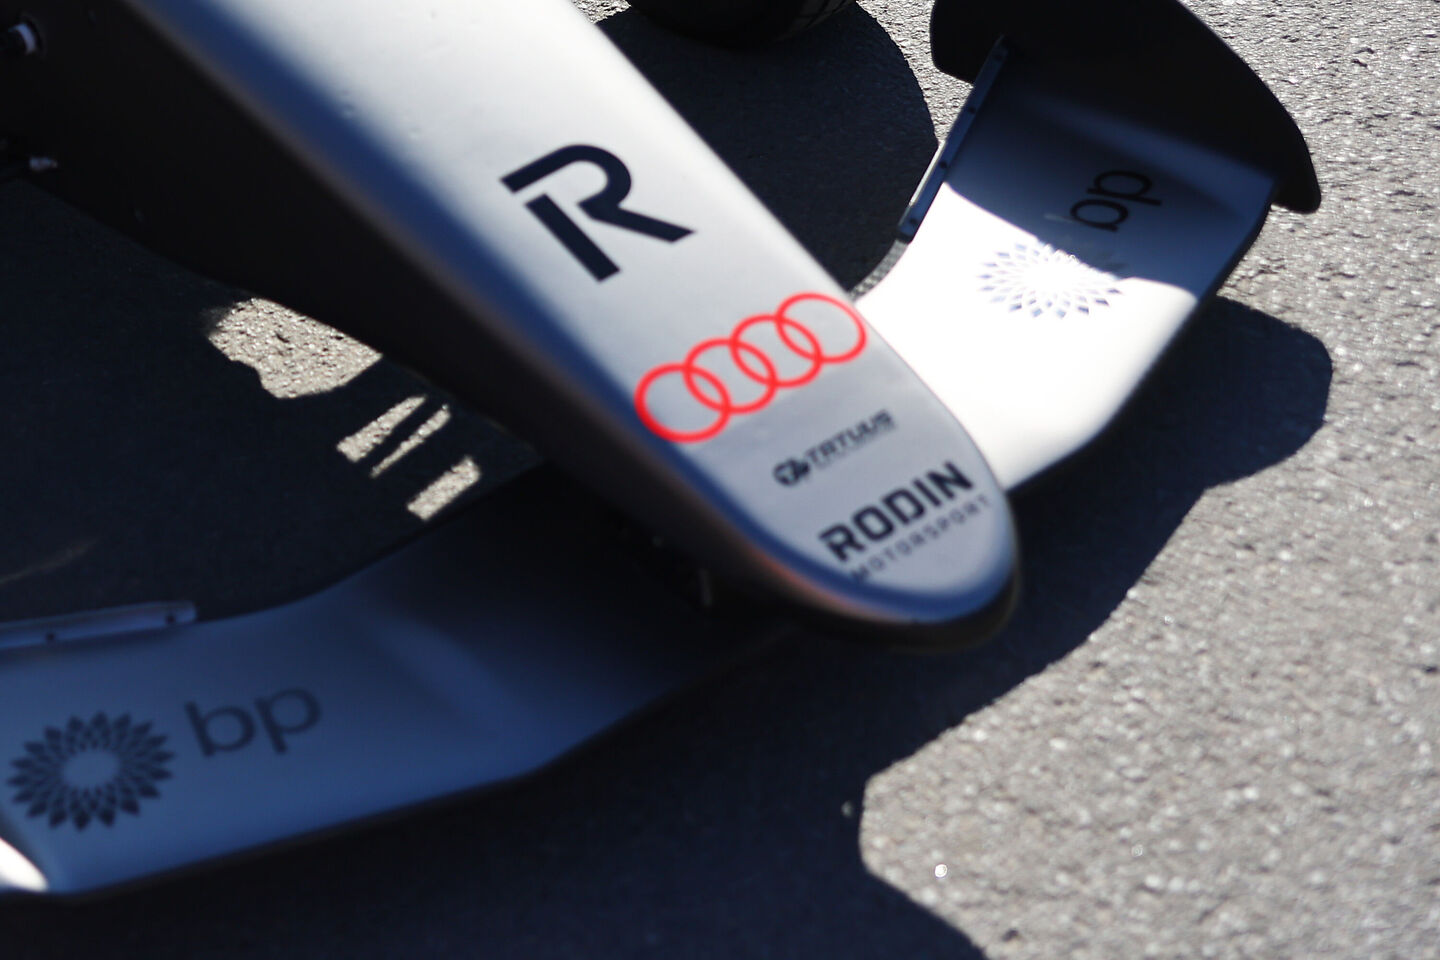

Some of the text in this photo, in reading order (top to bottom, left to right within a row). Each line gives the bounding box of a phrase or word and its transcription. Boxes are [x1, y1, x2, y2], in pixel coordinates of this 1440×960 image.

[499, 143, 696, 283] R
[1069, 170, 1162, 232] bp
[818, 458, 973, 562] RODIN
[851, 493, 990, 581] MOTORSPORT
[184, 688, 321, 756] bp
